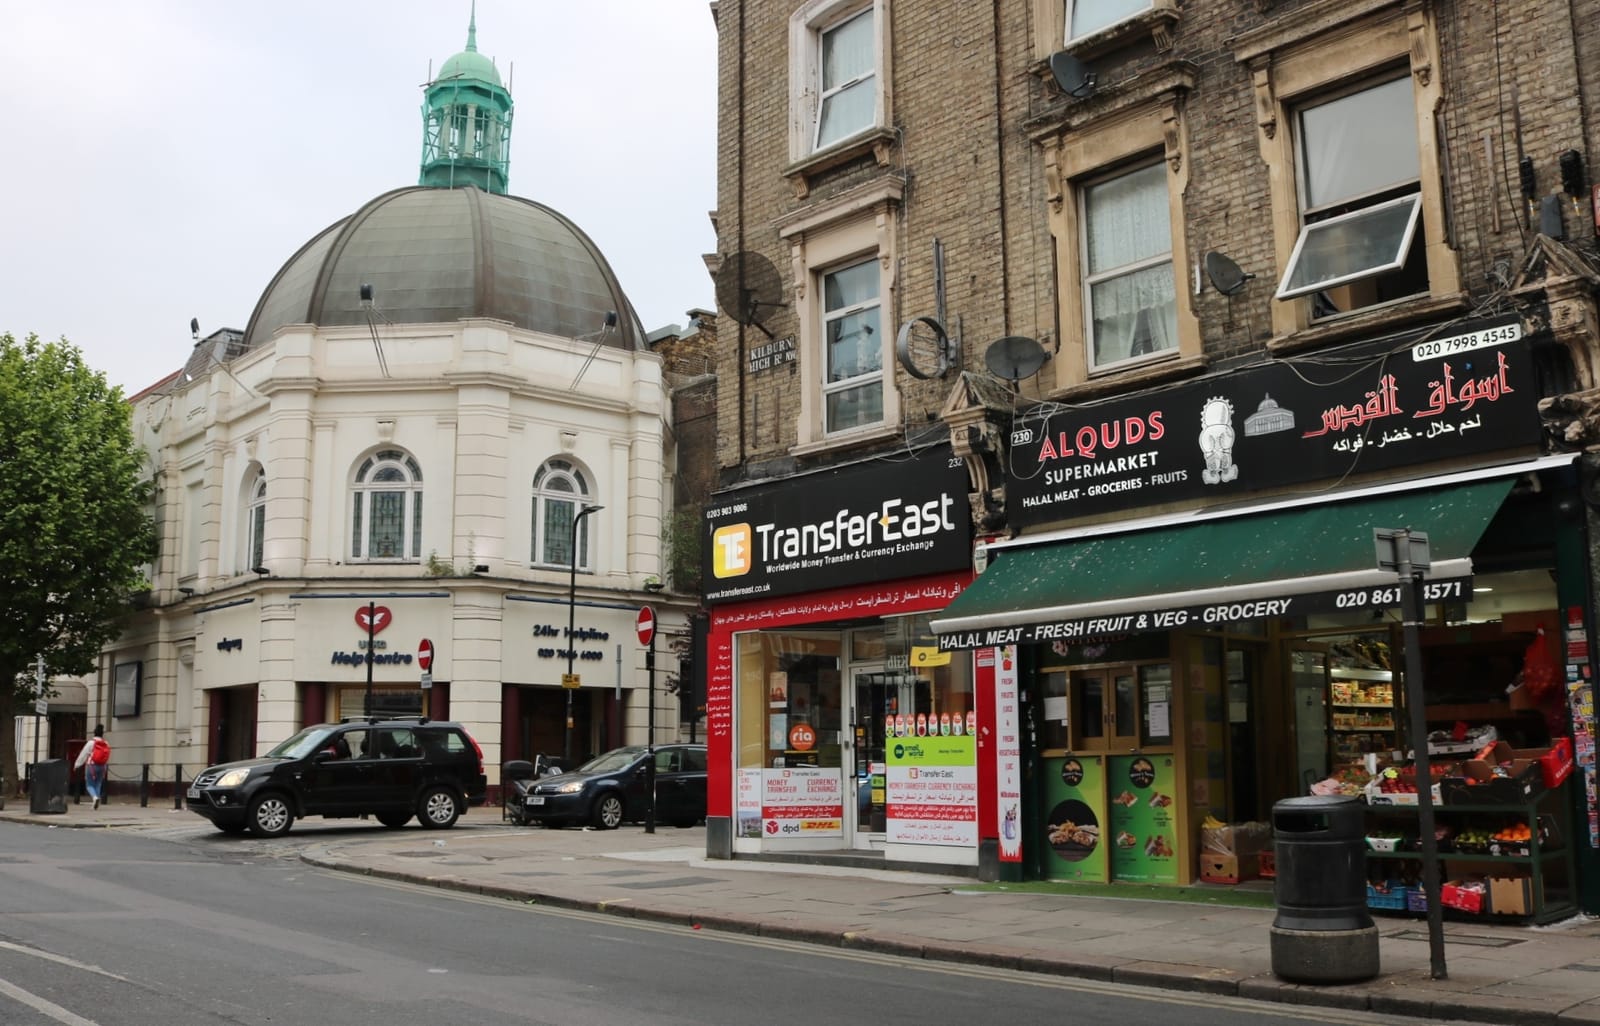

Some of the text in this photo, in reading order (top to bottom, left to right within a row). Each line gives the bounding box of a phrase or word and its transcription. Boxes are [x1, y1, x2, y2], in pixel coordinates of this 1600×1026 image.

[1417, 327, 1515, 358] 020 7998 4545
[1302, 374, 1404, 438] القدس
[1426, 421, 1455, 438] حلال
[1458, 414, 1481, 436] لحم
[1013, 433, 1030, 444] 230
[1038, 411, 1165, 462] ALQUDS
[1332, 434, 1363, 452] فواكه
[1378, 426, 1412, 447] خضار
[948, 457, 963, 468] 232
[1045, 451, 1159, 485] SUPERMARKET
[1022, 493, 1053, 507] HALAL
[1054, 489, 1081, 502] MEAT
[1087, 478, 1142, 497] GROCERIES
[1151, 469, 1188, 486] FRUITS
[766, 540, 934, 574] Worldwide Money Transfer & Currency Exchange
[706, 583, 771, 600] www.transfereast.co.uk
[1335, 592, 1367, 608] 020
[533, 624, 560, 637] 24hr
[940, 633, 983, 650] HALAL
[985, 628, 1023, 645] MEAT
[1034, 622, 1084, 640] FRESH
[1087, 615, 1134, 634] FRUIT
[1135, 614, 1148, 629] &
[1153, 610, 1188, 627] VEG
[1203, 598, 1292, 623] GROCERY
[792, 728, 813, 742] ria
[782, 823, 800, 834] dpd
[805, 821, 836, 829] DHL
